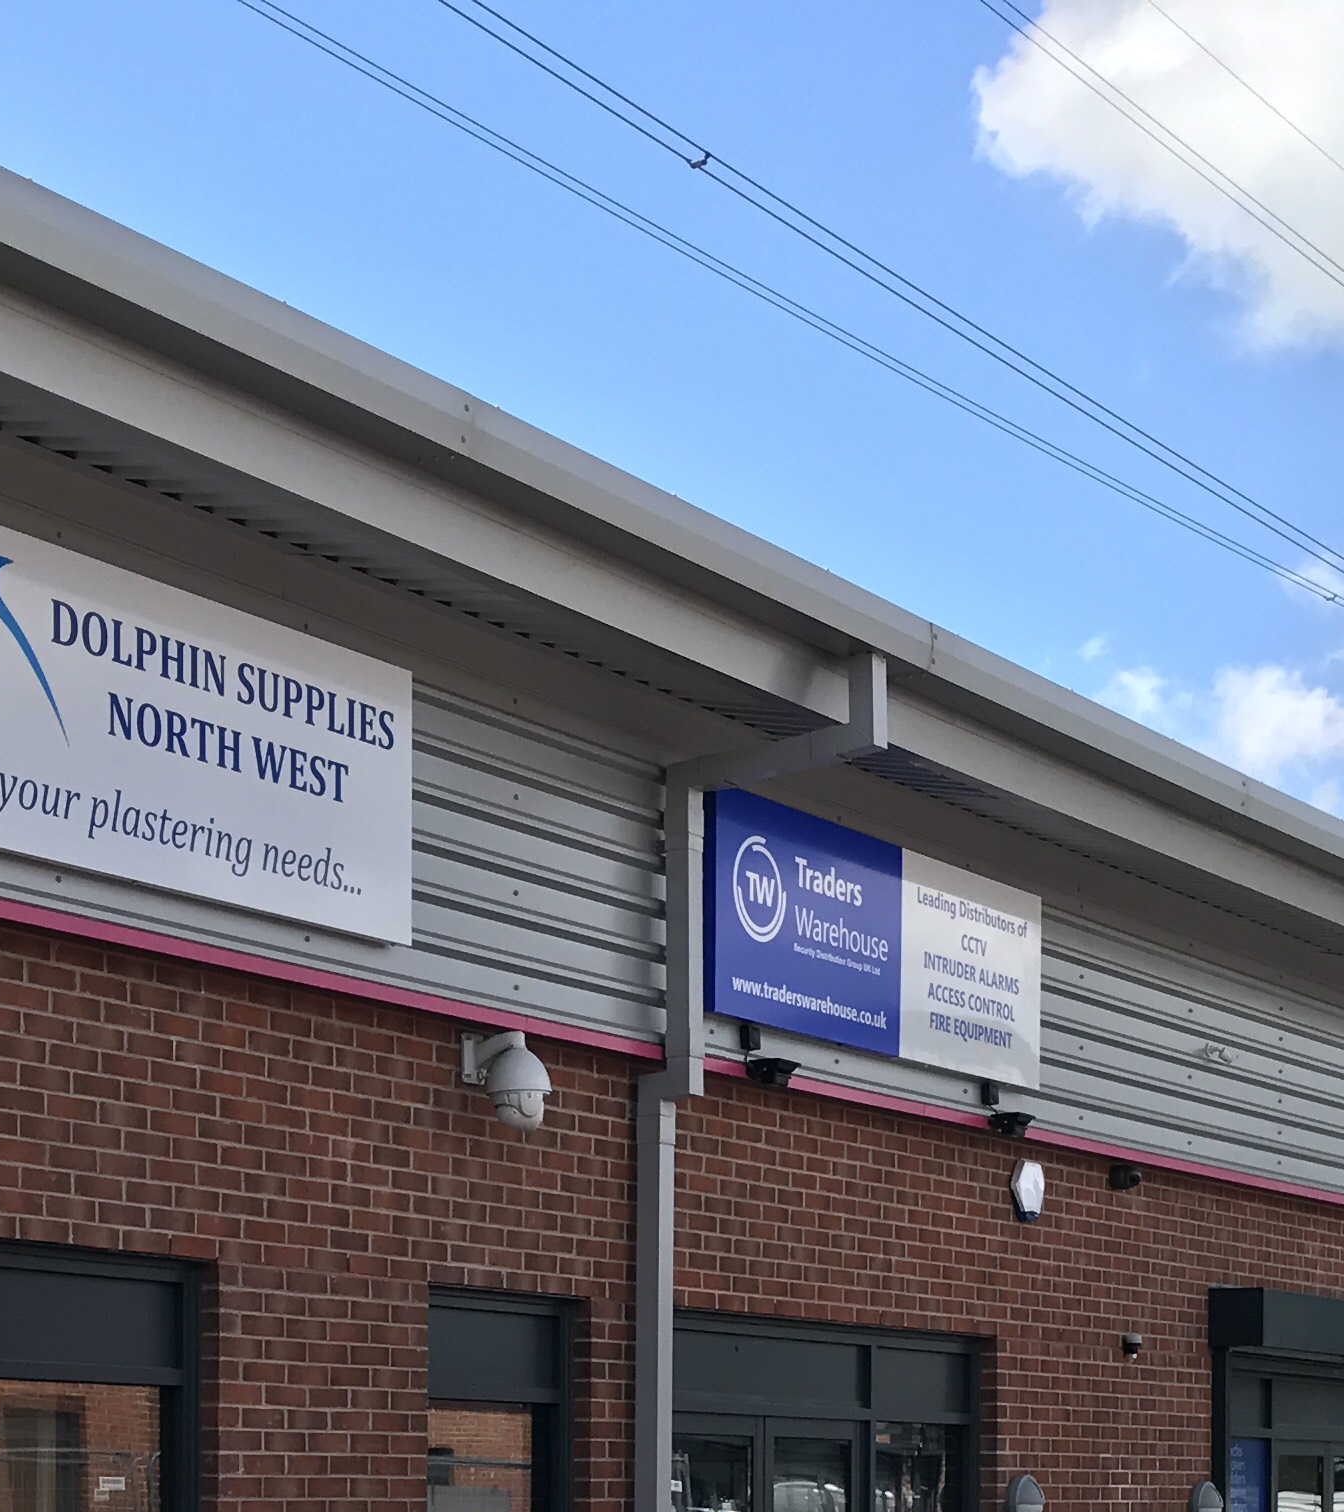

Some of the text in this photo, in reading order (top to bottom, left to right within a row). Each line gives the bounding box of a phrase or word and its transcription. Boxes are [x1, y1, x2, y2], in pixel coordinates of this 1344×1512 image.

[51, 599, 395, 751] DOLPHIN SUPPLIES
[108, 692, 349, 803] NORTH WEST
[87, 789, 253, 878] plastering
[262, 838, 362, 897] needs...
[746, 870, 775, 907] TW
[795, 856, 863, 907] Traders
[795, 905, 889, 962] Warehouse
[917, 886, 1028, 938] Leading Distributors of
[960, 933, 988, 957] CCTV
[923, 951, 1020, 995] INTRUDER ALARMS
[732, 976, 887, 1030] www.traderswarehouse.co.uk
[927, 982, 1016, 1022] ACCESS CONTROL
[929, 1011, 1013, 1050] FIRE EQUIPMENT
